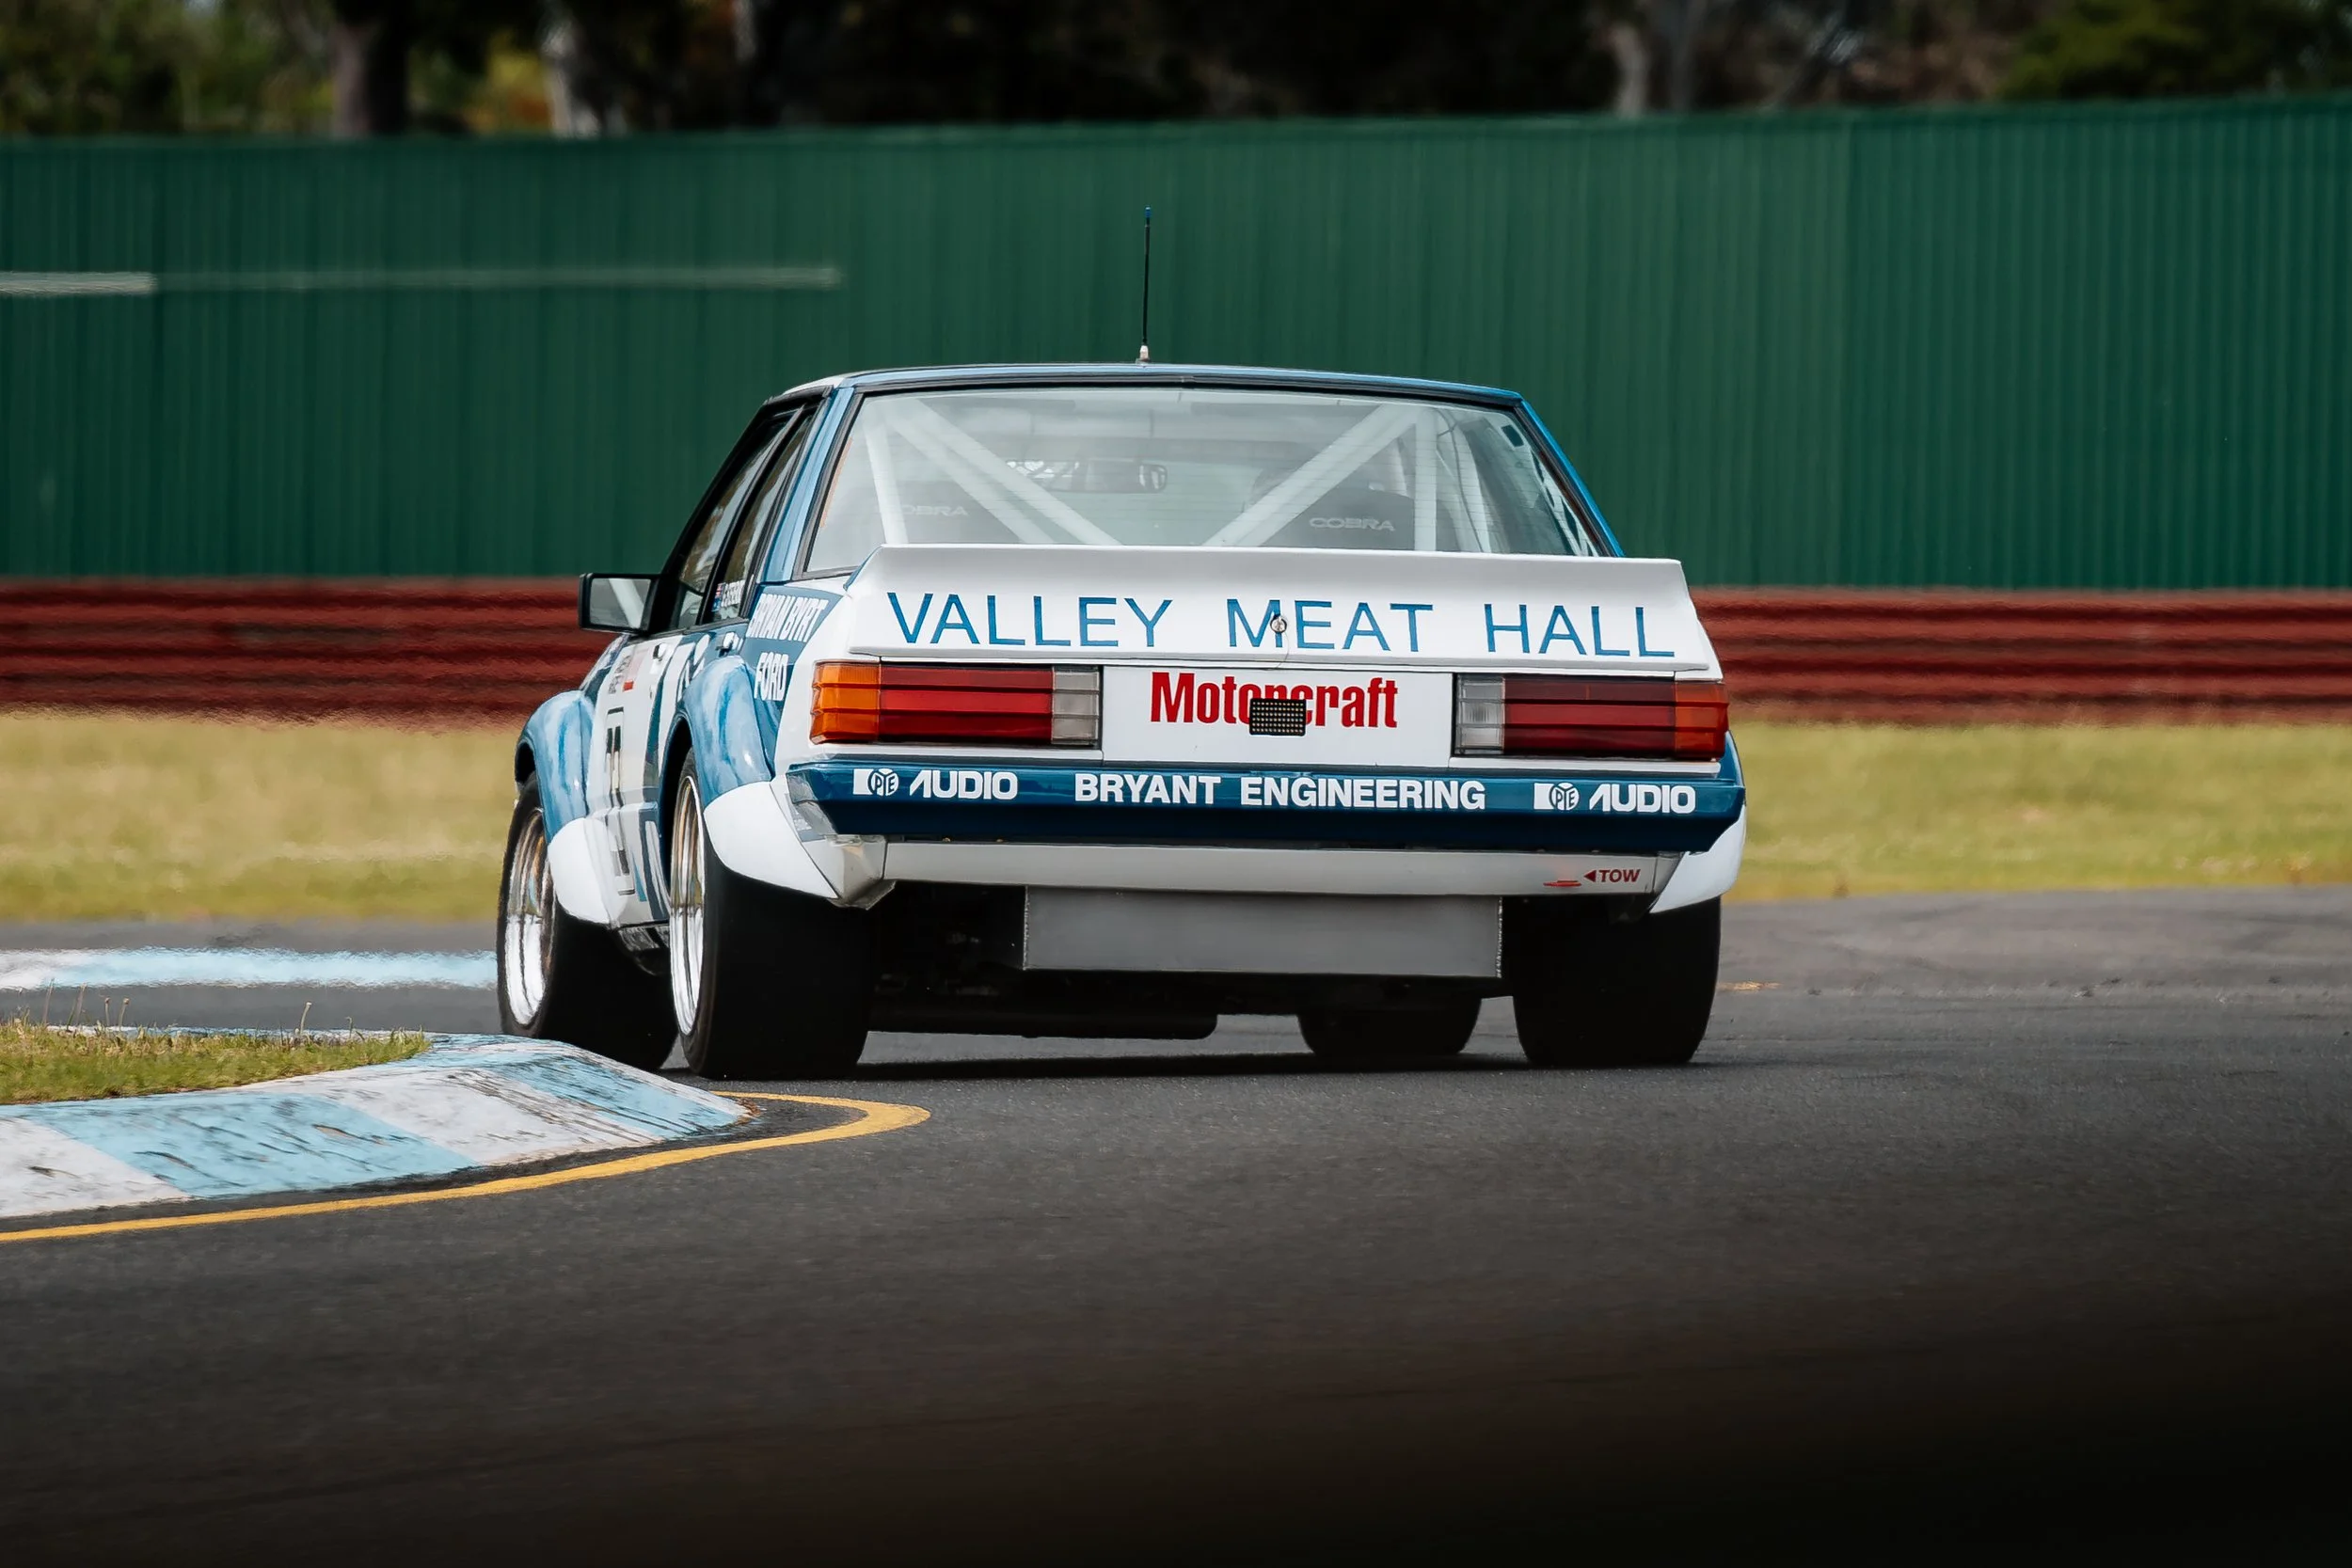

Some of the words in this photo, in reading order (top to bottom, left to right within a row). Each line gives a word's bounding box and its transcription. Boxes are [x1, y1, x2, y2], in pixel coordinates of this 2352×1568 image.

[900, 504, 969, 516] OBRA
[1309, 517, 1395, 532] COBRA
[778, 595, 830, 643] BYRT
[887, 592, 1173, 647] VALLEY
[1227, 598, 1434, 652] MEAT
[1484, 603, 1675, 657] HALL
[754, 651, 789, 702] FORD
[909, 769, 1019, 800] AUDIO
[1074, 772, 1221, 805] BRYANT
[1240, 776, 1486, 811] ENGINEERING
[1588, 783, 1696, 815] AUDIO
[1598, 868, 1641, 883] TOW
